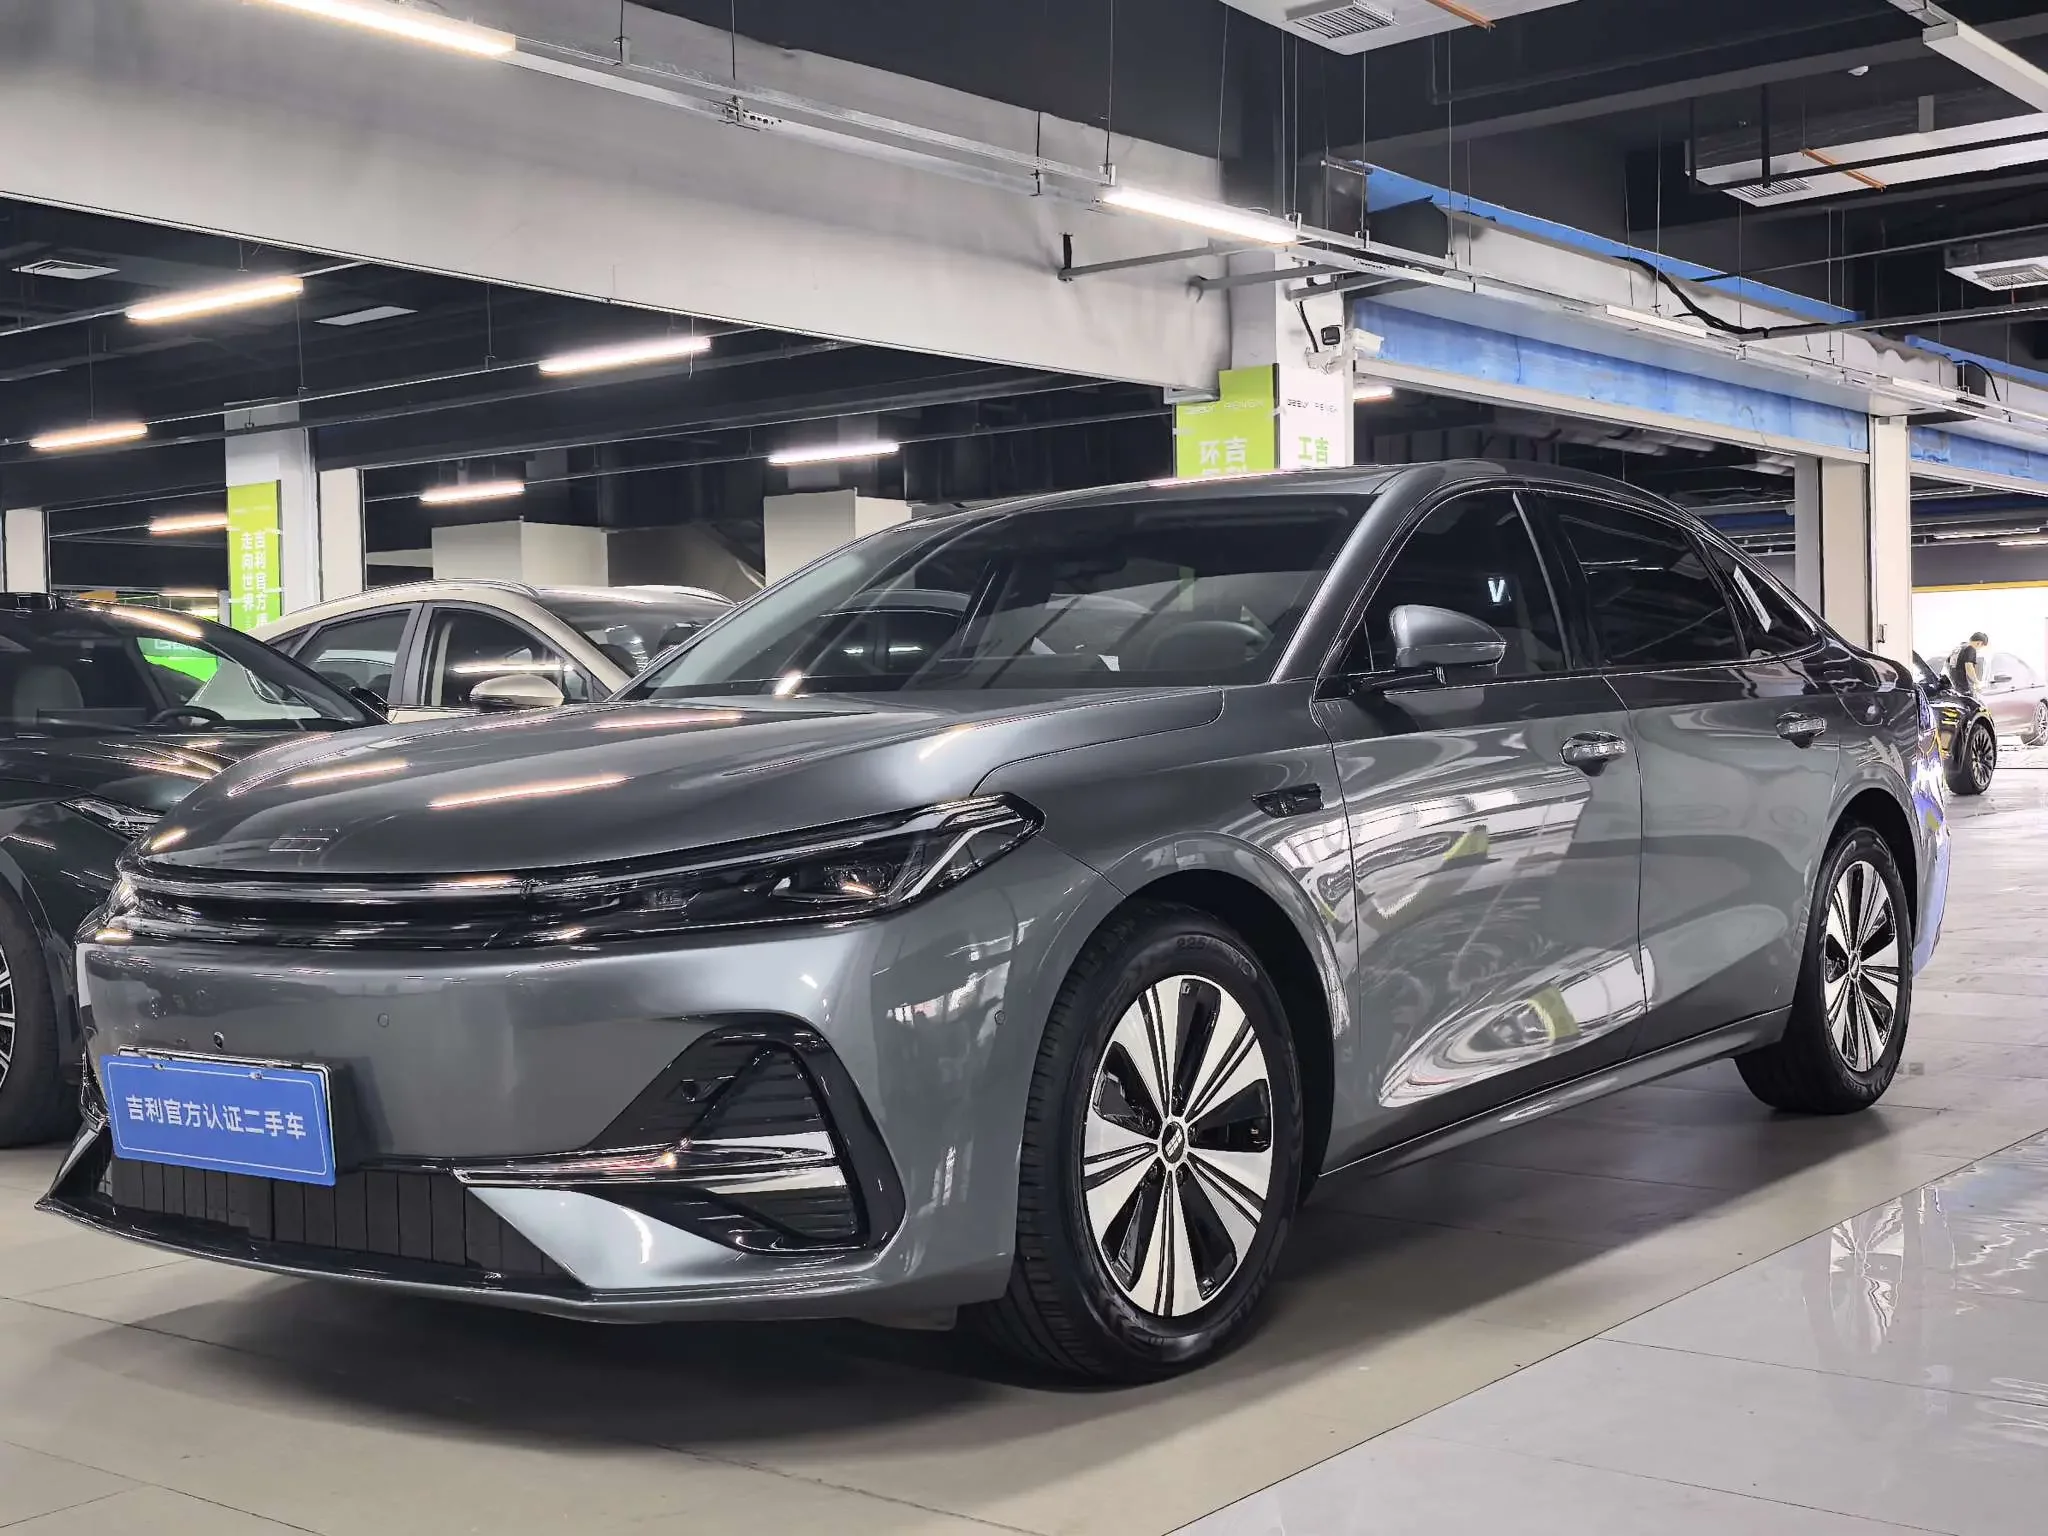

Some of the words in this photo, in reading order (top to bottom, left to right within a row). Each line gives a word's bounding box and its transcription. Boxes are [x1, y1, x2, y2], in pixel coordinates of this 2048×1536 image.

[125, 1094, 307, 1140] 吉利官方认证二手车
